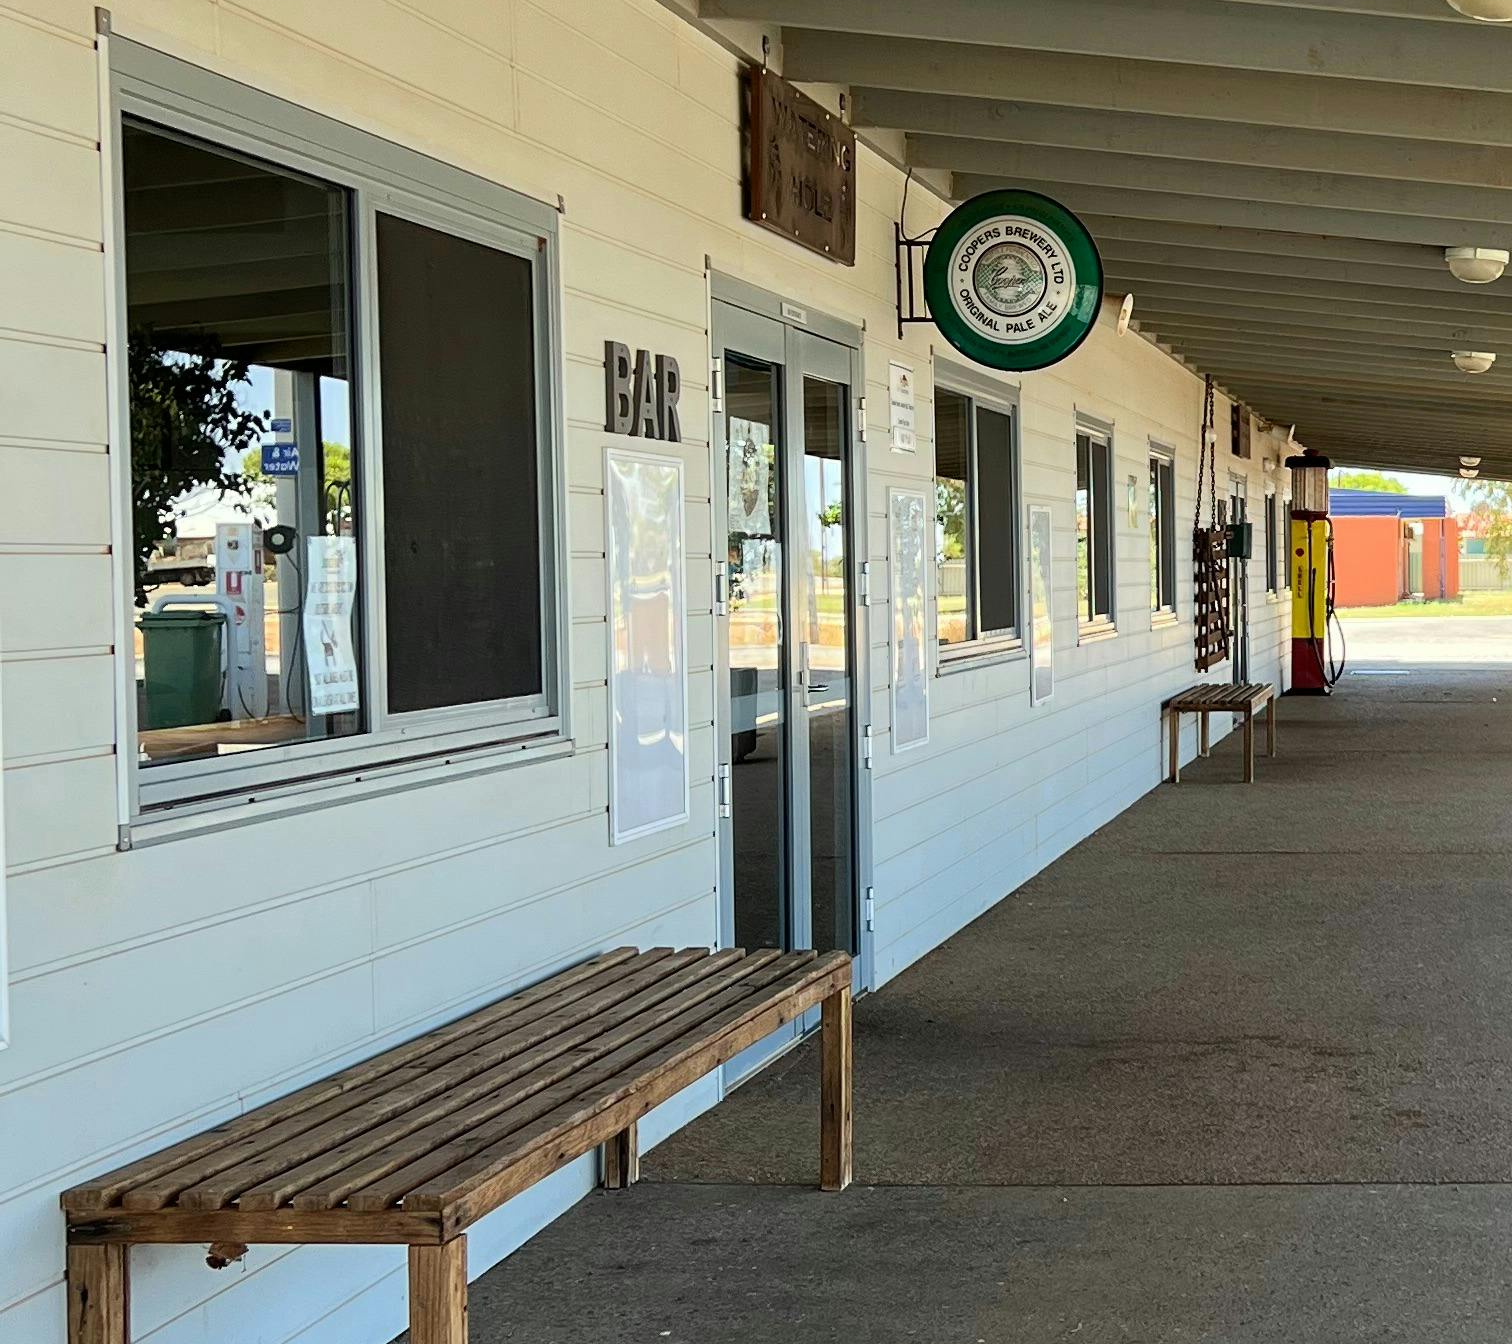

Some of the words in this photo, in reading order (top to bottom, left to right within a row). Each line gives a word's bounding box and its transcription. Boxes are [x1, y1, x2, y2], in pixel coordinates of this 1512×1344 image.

[958, 227, 1001, 272] COOPERS
[1005, 225, 1058, 259] BREWERY
[1051, 262, 1065, 284] LTD
[959, 288, 1000, 332] ORIGINAL
[1005, 318, 1036, 334] PALE
[1038, 300, 1058, 324] ALE
[604, 340, 682, 443] BAR
